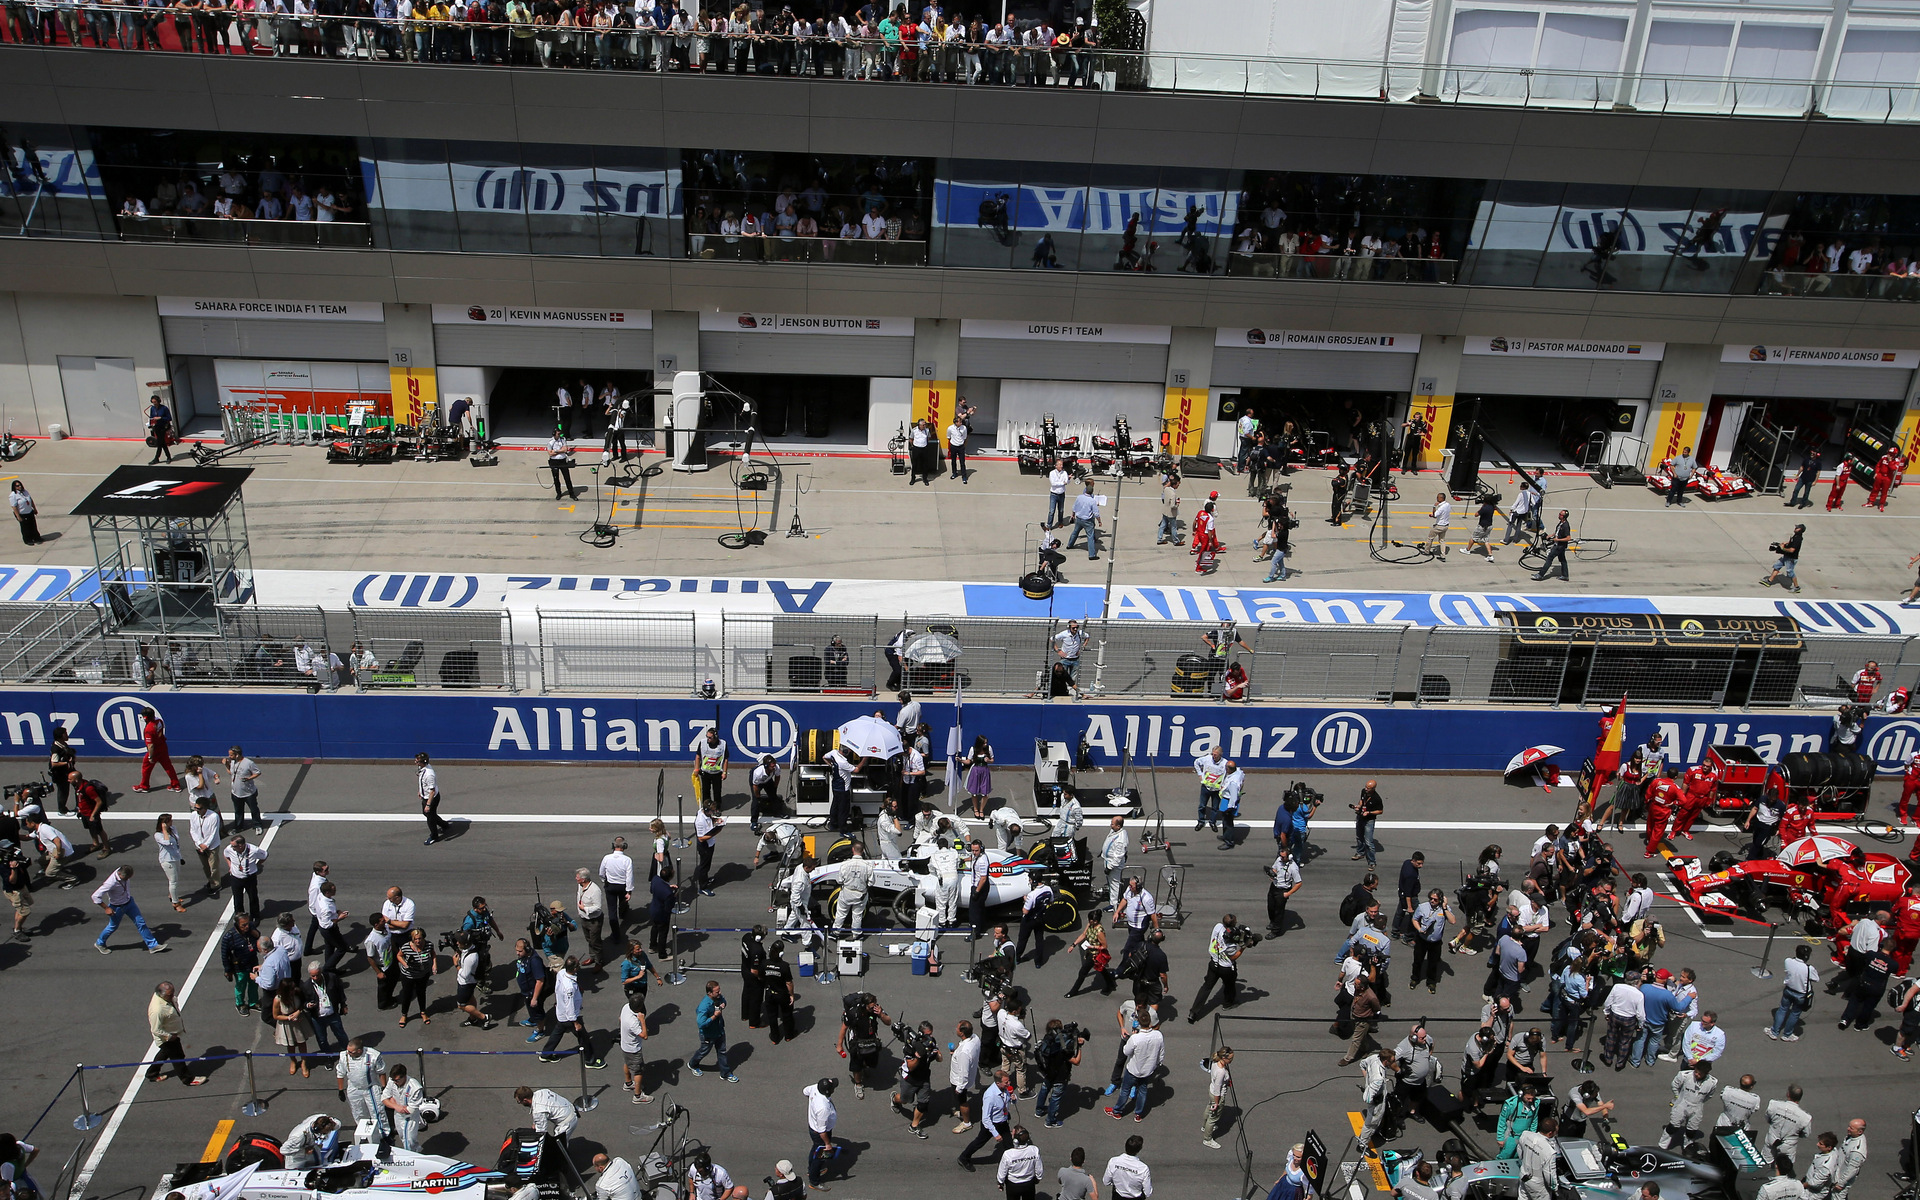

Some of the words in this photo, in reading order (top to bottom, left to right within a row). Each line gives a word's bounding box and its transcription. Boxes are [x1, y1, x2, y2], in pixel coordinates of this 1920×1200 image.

[194, 301, 238, 312] SAHARA
[239, 302, 273, 313] FORCE
[274, 303, 304, 314] INDIA
[305, 304, 317, 314] F1
[318, 304, 347, 315] TEAM
[490, 309, 502, 320] 20
[509, 310, 541, 321] KEVIN
[543, 311, 607, 322] MAGNUSSEN
[761, 317, 773, 327] 22
[780, 318, 820, 328] JENSON
[822, 319, 863, 329] BUTTON
[1028, 325, 1060, 335] LOTUS
[1061, 326, 1074, 335] F1
[1076, 326, 1103, 336] TEAM
[1268, 333, 1281, 343] 08
[1287, 334, 1325, 345] ROMAIN
[1326, 335, 1377, 346] GROSJEAN
[1510, 341, 1521, 350] 13
[1527, 342, 1564, 352] PASTOR
[1566, 343, 1625, 354] MALDONADO
[394, 353, 408, 362] 18
[1772, 349, 1782, 358] 14
[1789, 350, 1840, 360] FERNANDO
[1841, 351, 1879, 361] ALONSO
[660, 359, 673, 369] 17
[920, 366, 932, 376] 16
[1174, 374, 1186, 383] 15
[1421, 382, 1433, 391] 14
[1661, 389, 1676, 399] 12a
[927, 389, 940, 430] DH
[1102, 587, 1418, 626] Allianz
[1571, 616, 1634, 629] LOTUS
[1715, 618, 1779, 632] LOTUS
[0, 712, 85, 746] nz
[488, 706, 718, 752] Allianz
[1081, 714, 1299, 759] Allianz
[1656, 722, 1825, 765] Allian
[988, 866, 1013, 874] ARTINI
[1734, 1128, 1766, 1168] PETRONAS
[412, 1177, 458, 1190] MARTINI
